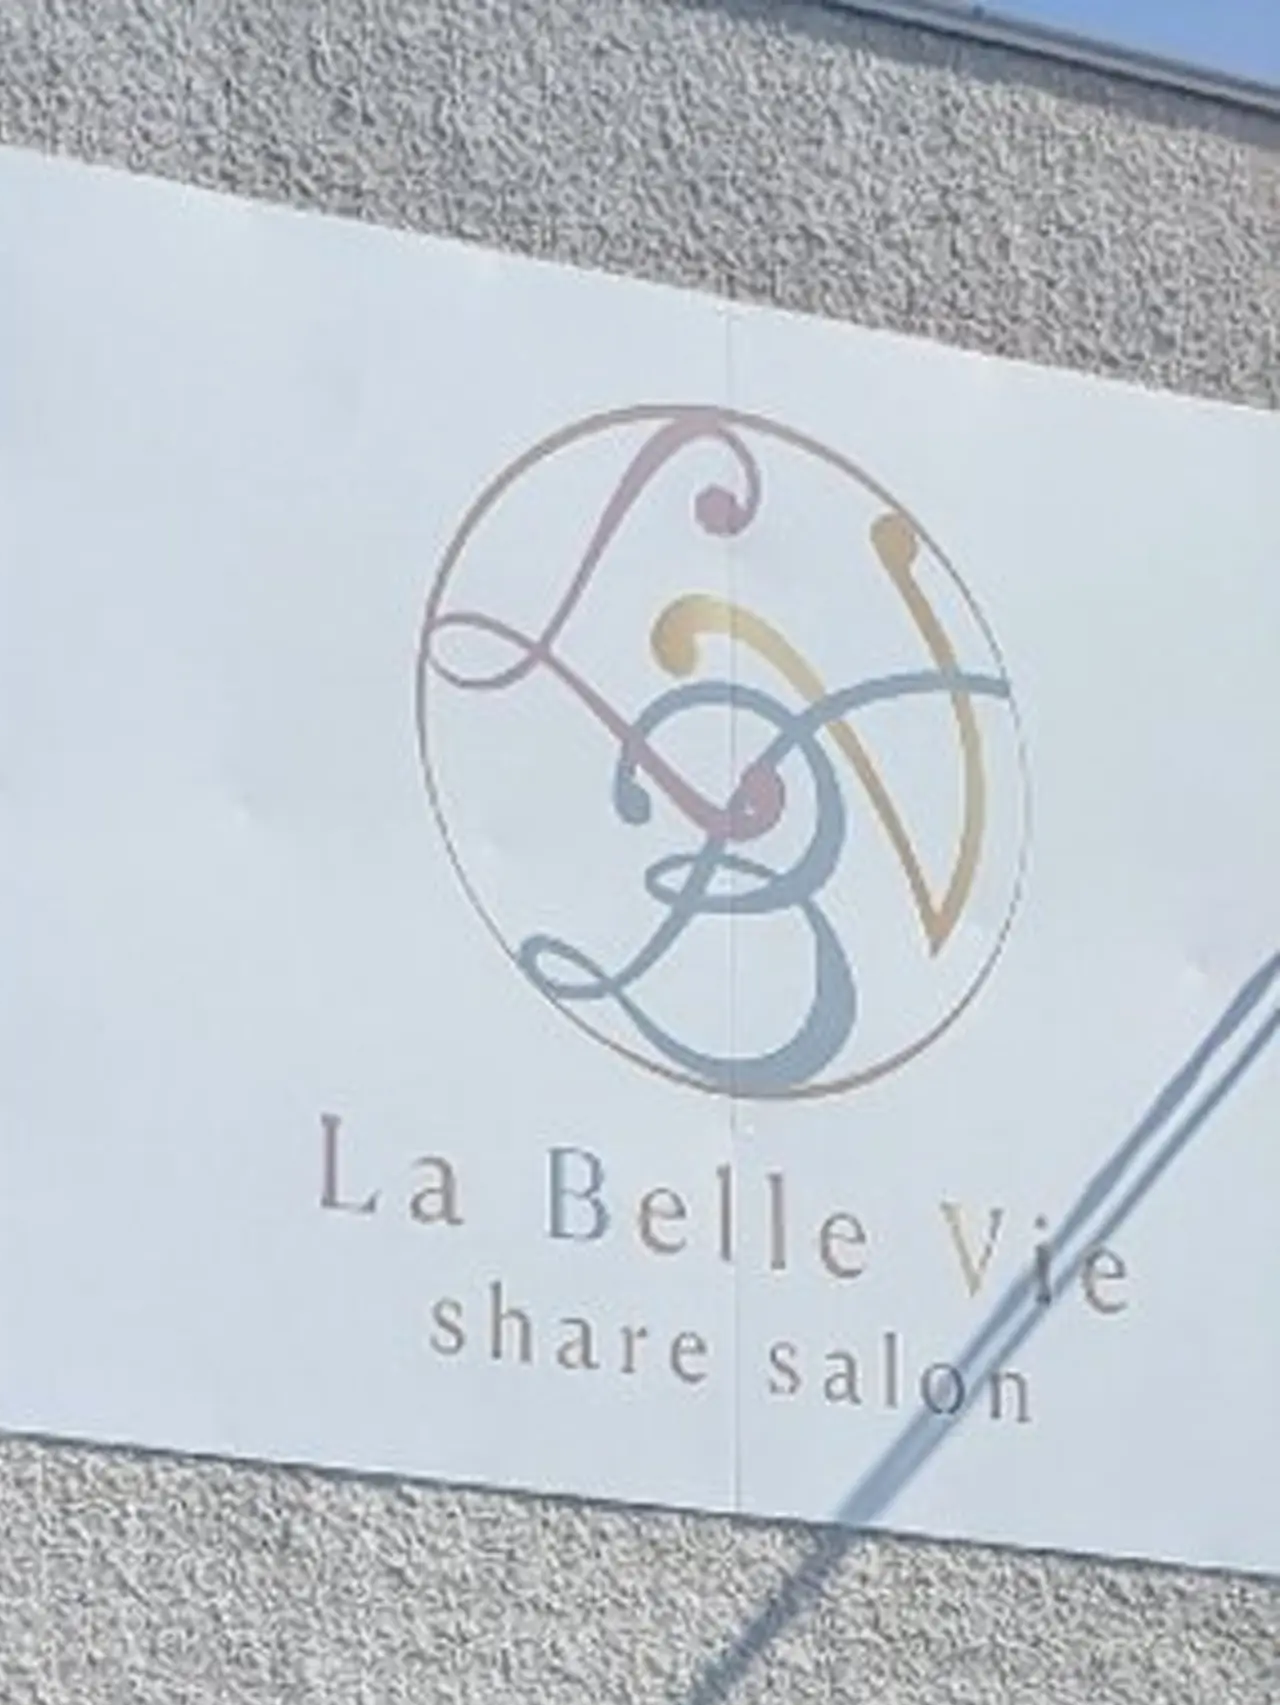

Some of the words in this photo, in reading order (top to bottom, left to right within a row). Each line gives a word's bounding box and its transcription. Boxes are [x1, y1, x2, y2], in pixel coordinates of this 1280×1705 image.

[318, 1112, 465, 1227] La
[545, 1145, 870, 1281] Belle
[939, 1199, 1132, 1317] Vie
[428, 1280, 711, 1384] share
[766, 1330, 1033, 1425] salon
